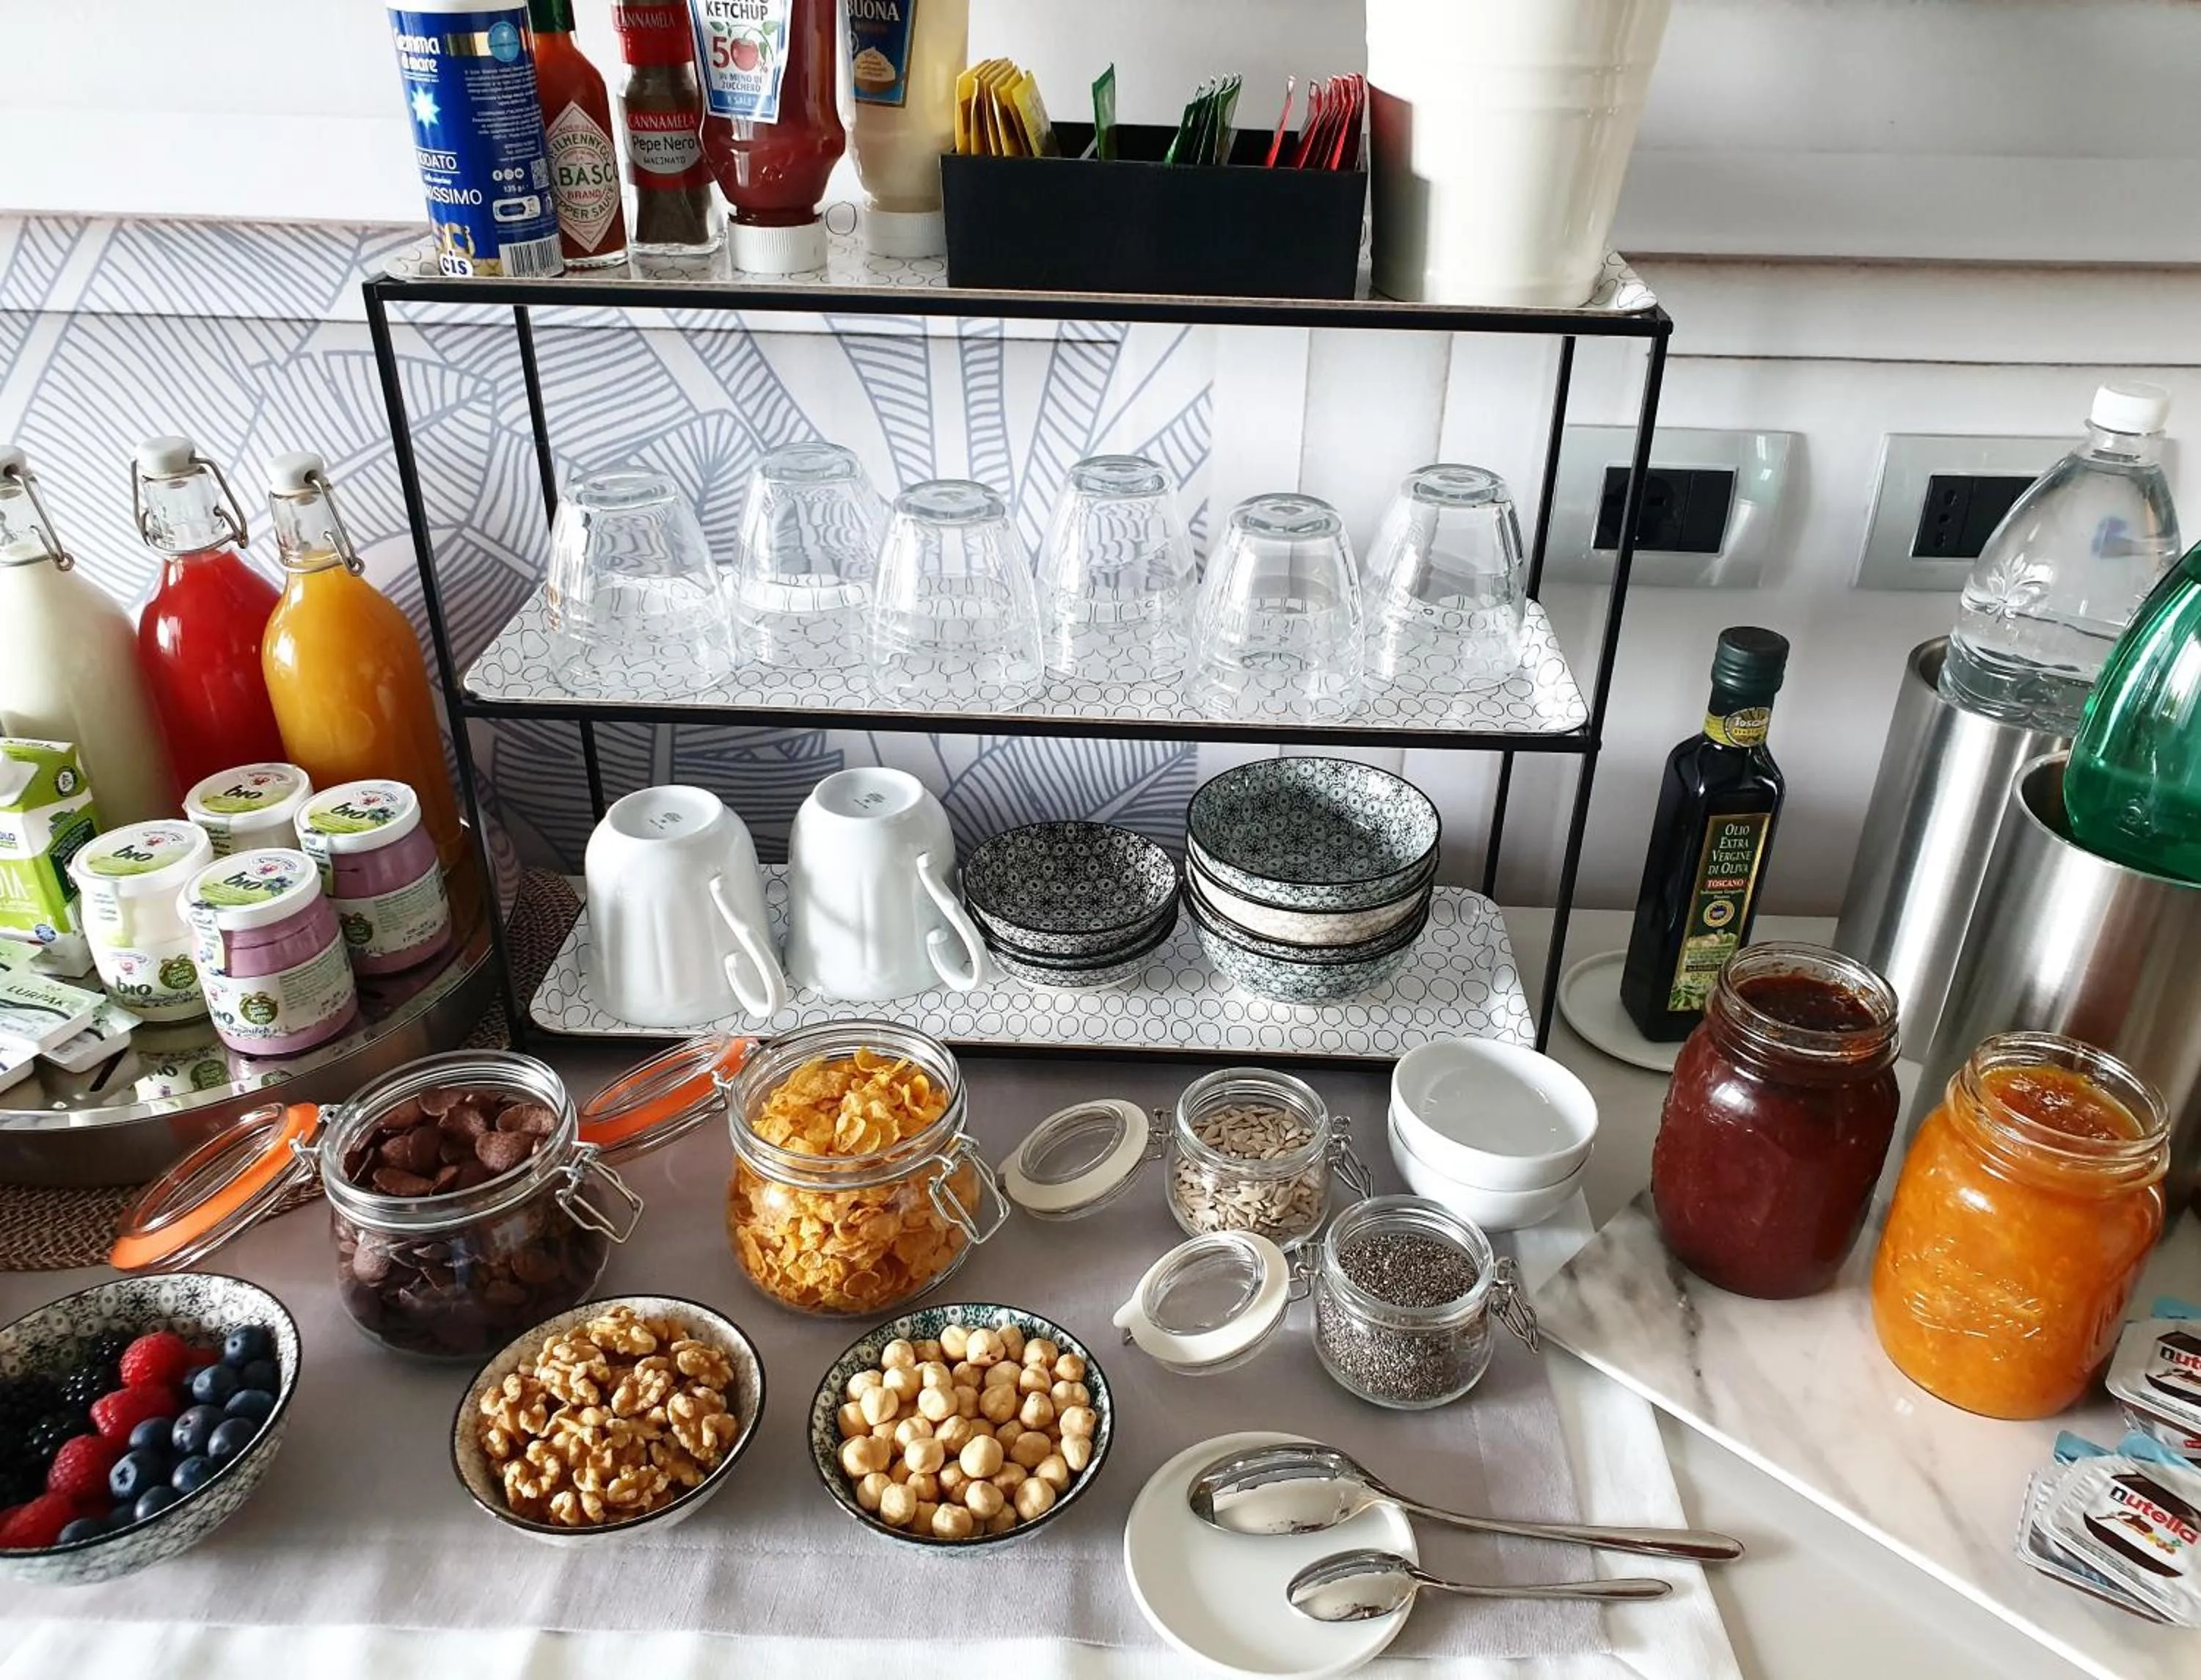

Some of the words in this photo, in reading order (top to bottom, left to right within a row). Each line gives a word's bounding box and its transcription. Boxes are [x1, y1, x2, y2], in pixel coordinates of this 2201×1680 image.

[705, 0, 768, 21] KETCHUP
[632, 135, 661, 153] Pepe
[663, 136, 696, 150] Nero
[222, 784, 264, 800] bio
[330, 801, 367, 819] bio
[1725, 823, 1750, 836] OLIO
[1719, 836, 1750, 850] EXTRA
[112, 844, 154, 862] bio
[1711, 849, 1753, 863] VERGINE
[222, 870, 263, 891] bio
[1707, 879, 1745, 888] TOSCANO
[115, 975, 153, 996] bio
[2109, 1486, 2198, 1545] nutella
